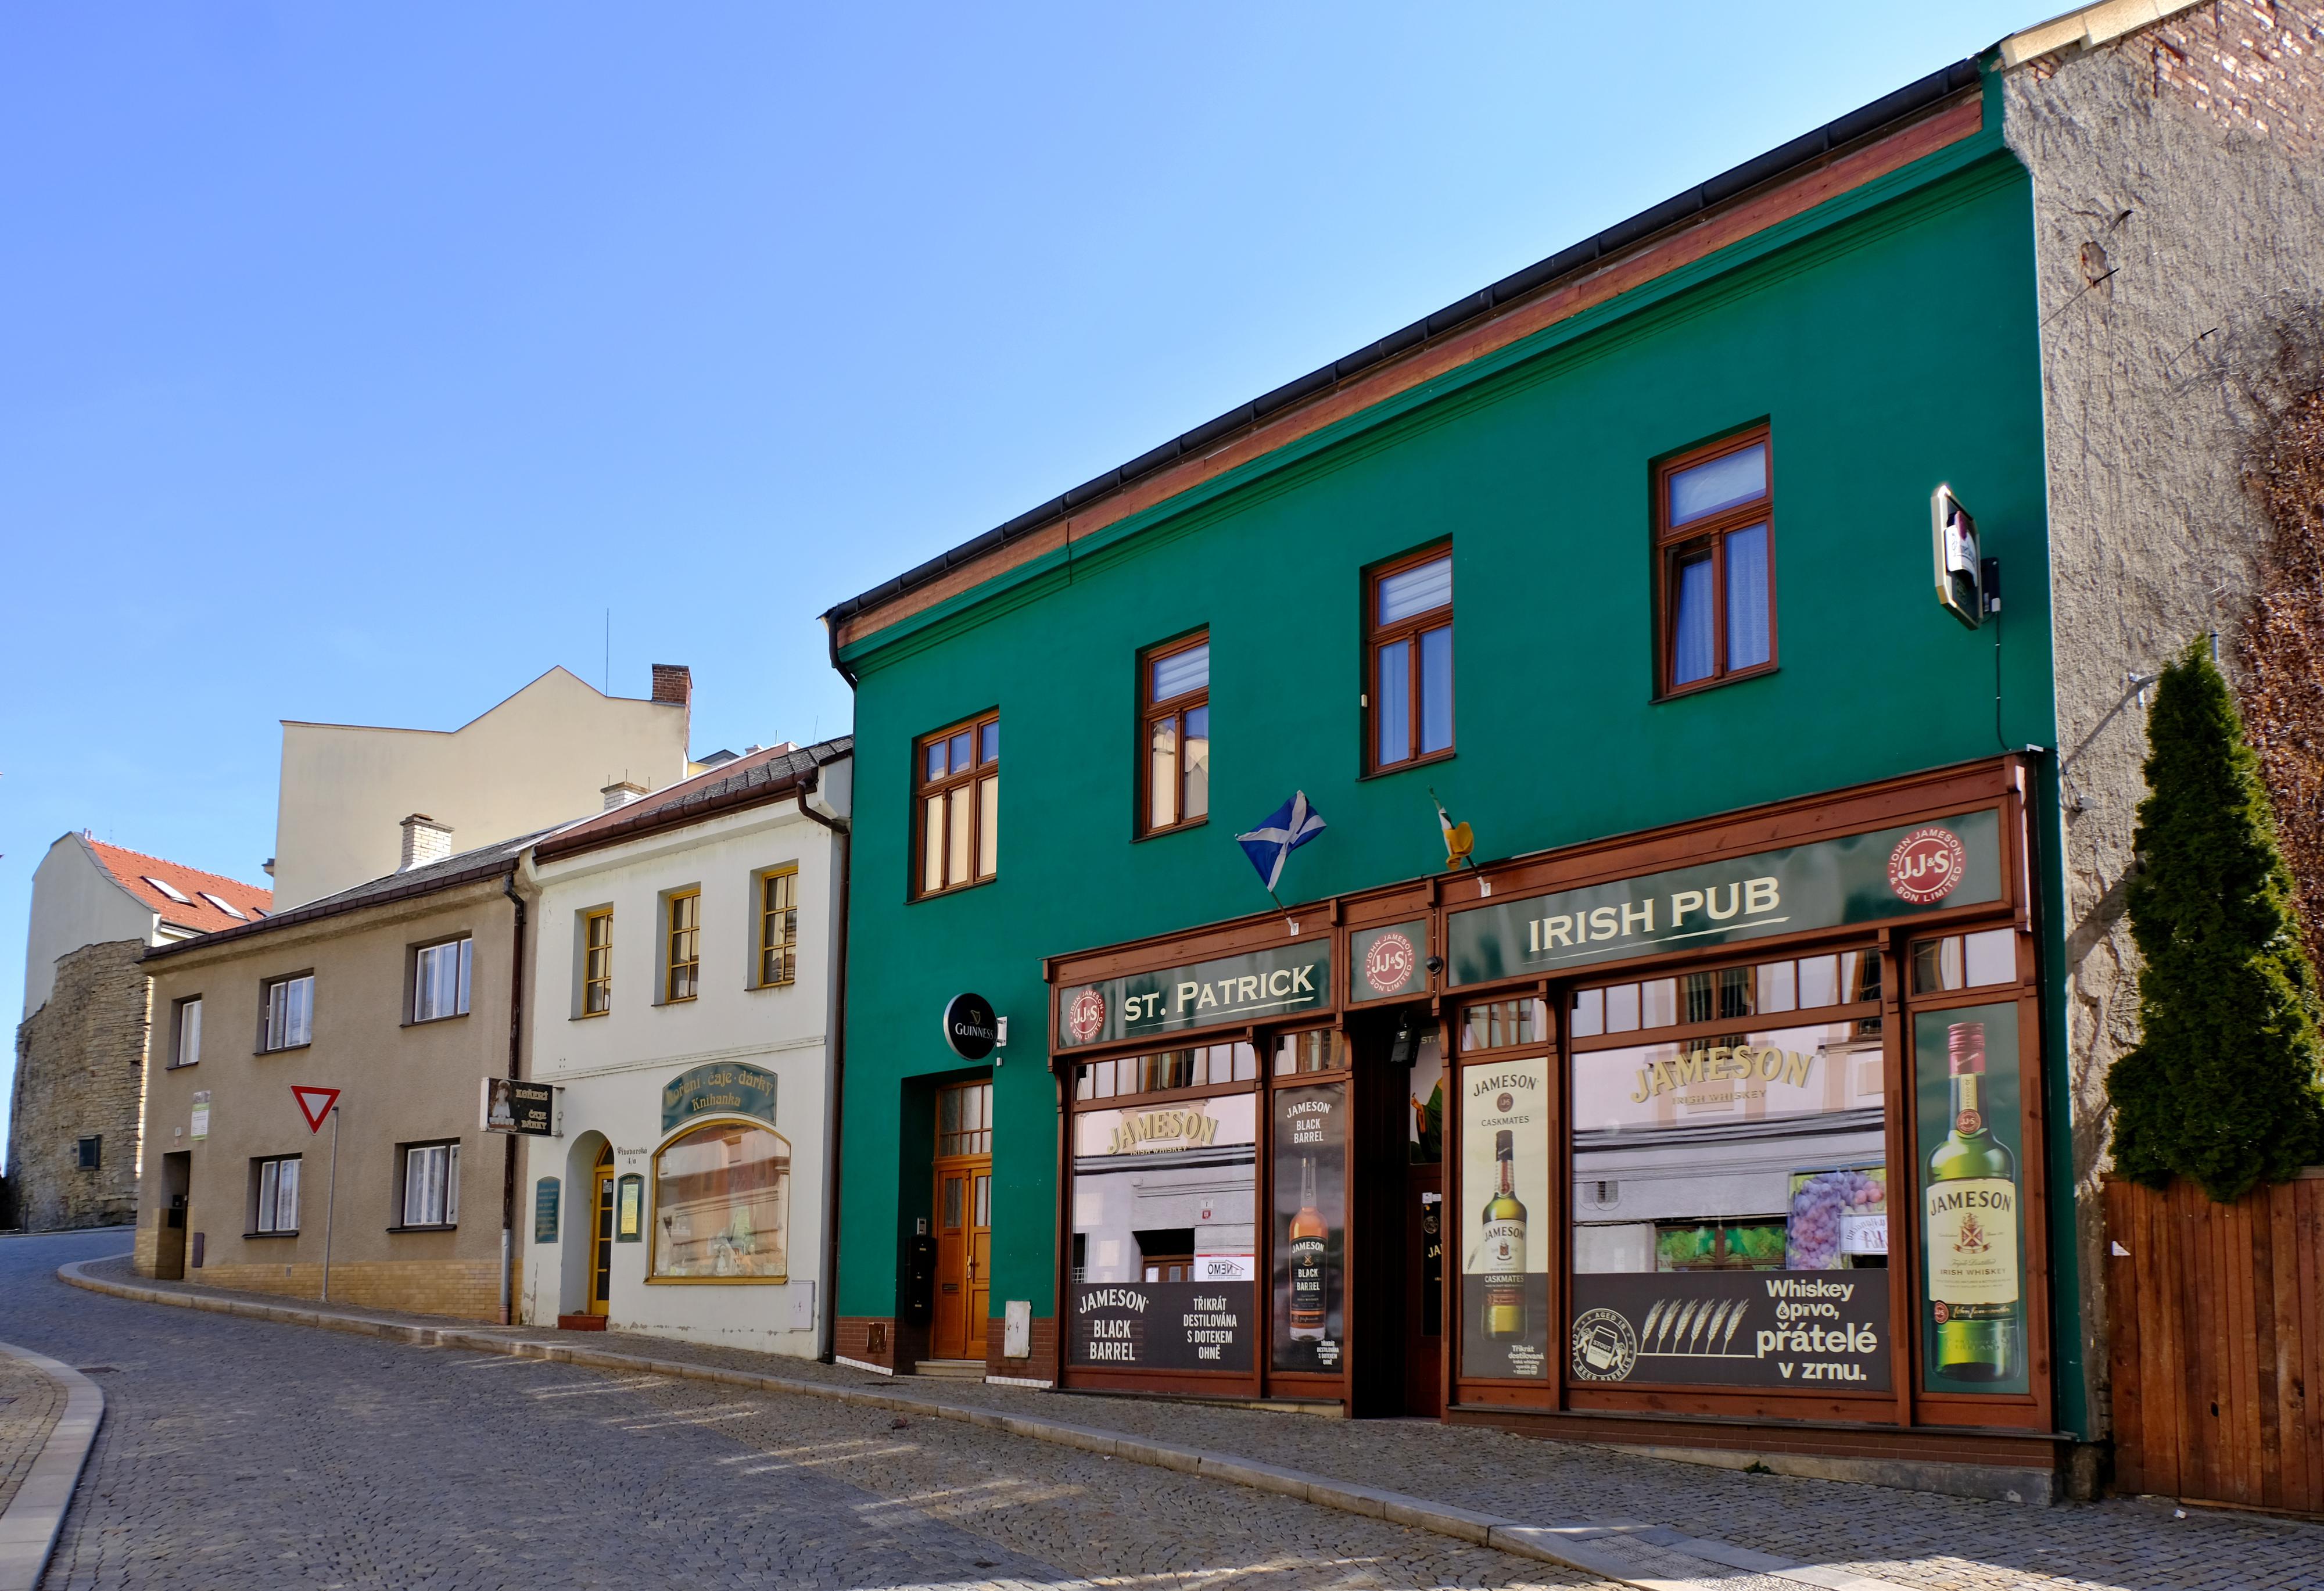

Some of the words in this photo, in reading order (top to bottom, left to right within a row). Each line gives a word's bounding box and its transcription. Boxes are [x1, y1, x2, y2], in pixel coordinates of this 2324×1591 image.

[1915, 829, 1963, 855] JAMESON
[1889, 837, 1911, 868] JOHN
[1898, 850, 1949, 879] JJ&S
[1923, 866, 1961, 902] LIMITED
[1896, 887, 1919, 902] SON
[1529, 898, 1655, 952] IRISH
[1671, 876, 1780, 927] PUB
[1367, 940, 1380, 963] JOHN
[1383, 934, 1412, 956] JAMESON
[1372, 951, 1404, 973] JJ&S
[1371, 979, 1384, 991] SON
[1387, 965, 1412, 991] LIMITED
[1082, 990, 1104, 1009] JAMESON
[1125, 991, 1166, 1021] ST.
[1177, 965, 1315, 1013] PATRICK
[1070, 996, 1080, 1015] JOHN
[1074, 1005, 1098, 1024] JJ&S
[955, 1023, 994, 1040] GUINNESS
[1073, 1029, 1083, 1039] SON
[1084, 1016, 1103, 1040] LIMITED
[708, 1070, 732, 1088] čaje
[738, 1070, 773, 1096] dárky
[1631, 1045, 1815, 1104] JAMESON
[1473, 1074, 1537, 1096] JAMESON
[691, 1092, 741, 1112] Knihanka
[1673, 1095, 1705, 1105] IRISH
[1709, 1090, 1767, 1102] WHISKEY
[1287, 1101, 1330, 1118] JAMESON
[1296, 1119, 1321, 1131] BLACK
[1481, 1116, 1529, 1127] CASKMATES
[1107, 1110, 1219, 1155] JAMESON
[1294, 1131, 1324, 1144] BARREL
[1130, 1147, 1151, 1156] IRISH
[1153, 1145, 1190, 1154] WHISKEY
[1931, 1191, 2011, 1216] JAMESON
[1484, 1227, 1525, 1242] JAMESON
[1292, 1241, 1324, 1253] JAMESON
[1298, 1268, 1318, 1278] BLACK
[1484, 1275, 1525, 1283] CASKMATES
[1296, 1282, 1320, 1291] BARREL
[1765, 1279, 1855, 1302] Whiskey
[1079, 1289, 1147, 1314] JAMESON
[1193, 1295, 1227, 1311] TŘIKRÁT
[1183, 1311, 1238, 1327] DESTILOVÁNA
[1595, 1312, 1616, 1321] AGED
[1618, 1320, 1626, 1330] IN
[1790, 1303, 1839, 1321] pivo,
[1093, 1320, 1131, 1338] BLACK
[1187, 1330, 1193, 1343] S
[1195, 1330, 1232, 1343] DOTEKEM
[1593, 1339, 1612, 1351] STOUT
[1756, 1322, 1878, 1359] přátelé
[1090, 1341, 1135, 1360] BARREL
[1198, 1344, 1221, 1359] OHNĚ
[1778, 1363, 1794, 1378] v
[1802, 1363, 1867, 1381] zrnu.
